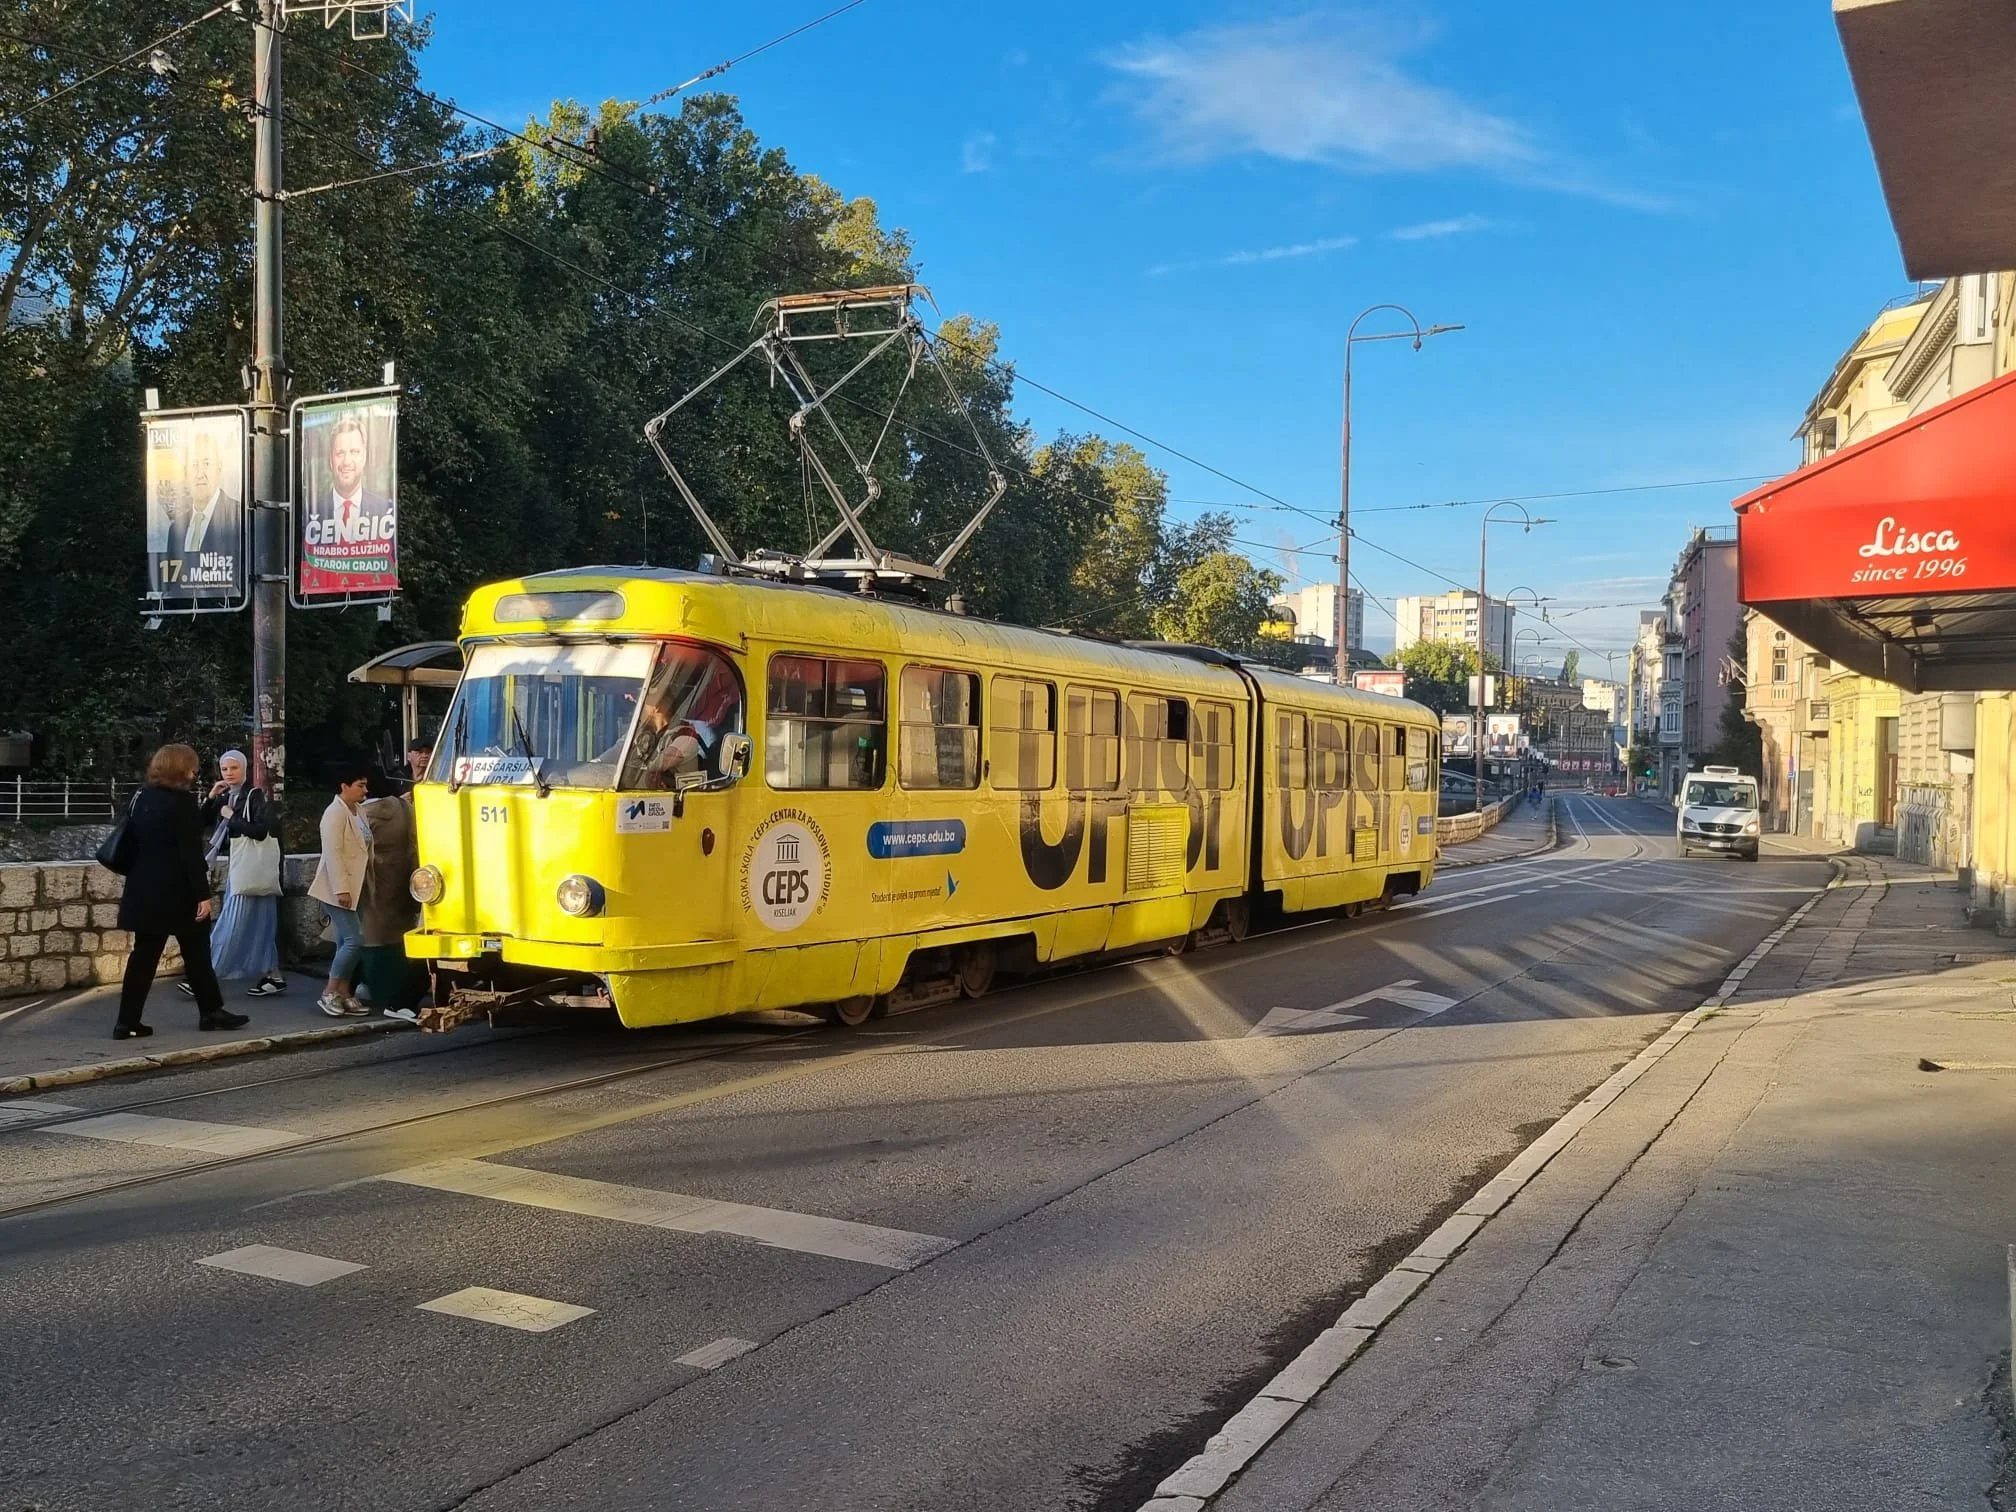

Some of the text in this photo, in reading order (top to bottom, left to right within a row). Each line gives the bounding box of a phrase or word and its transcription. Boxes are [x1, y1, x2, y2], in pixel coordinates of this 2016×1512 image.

[305, 508, 395, 545] ČENGIĆ
[1859, 517, 1960, 557] Lisca
[313, 542, 390, 556] HRABRO SLUŽIMO
[160, 560, 233, 582] 17. Memić
[200, 552, 233, 571] Nijaz
[313, 558, 388, 571] STAROM GRADU
[1851, 557, 1968, 582] since 1996
[481, 806, 508, 823] 511
[882, 830, 955, 848] www.ceps.edu.ba
[740, 877, 751, 913] VISOKA
[797, 810, 806, 822] ZA
[806, 815, 831, 860] POSLOVNE
[762, 870, 809, 905] CEPS
